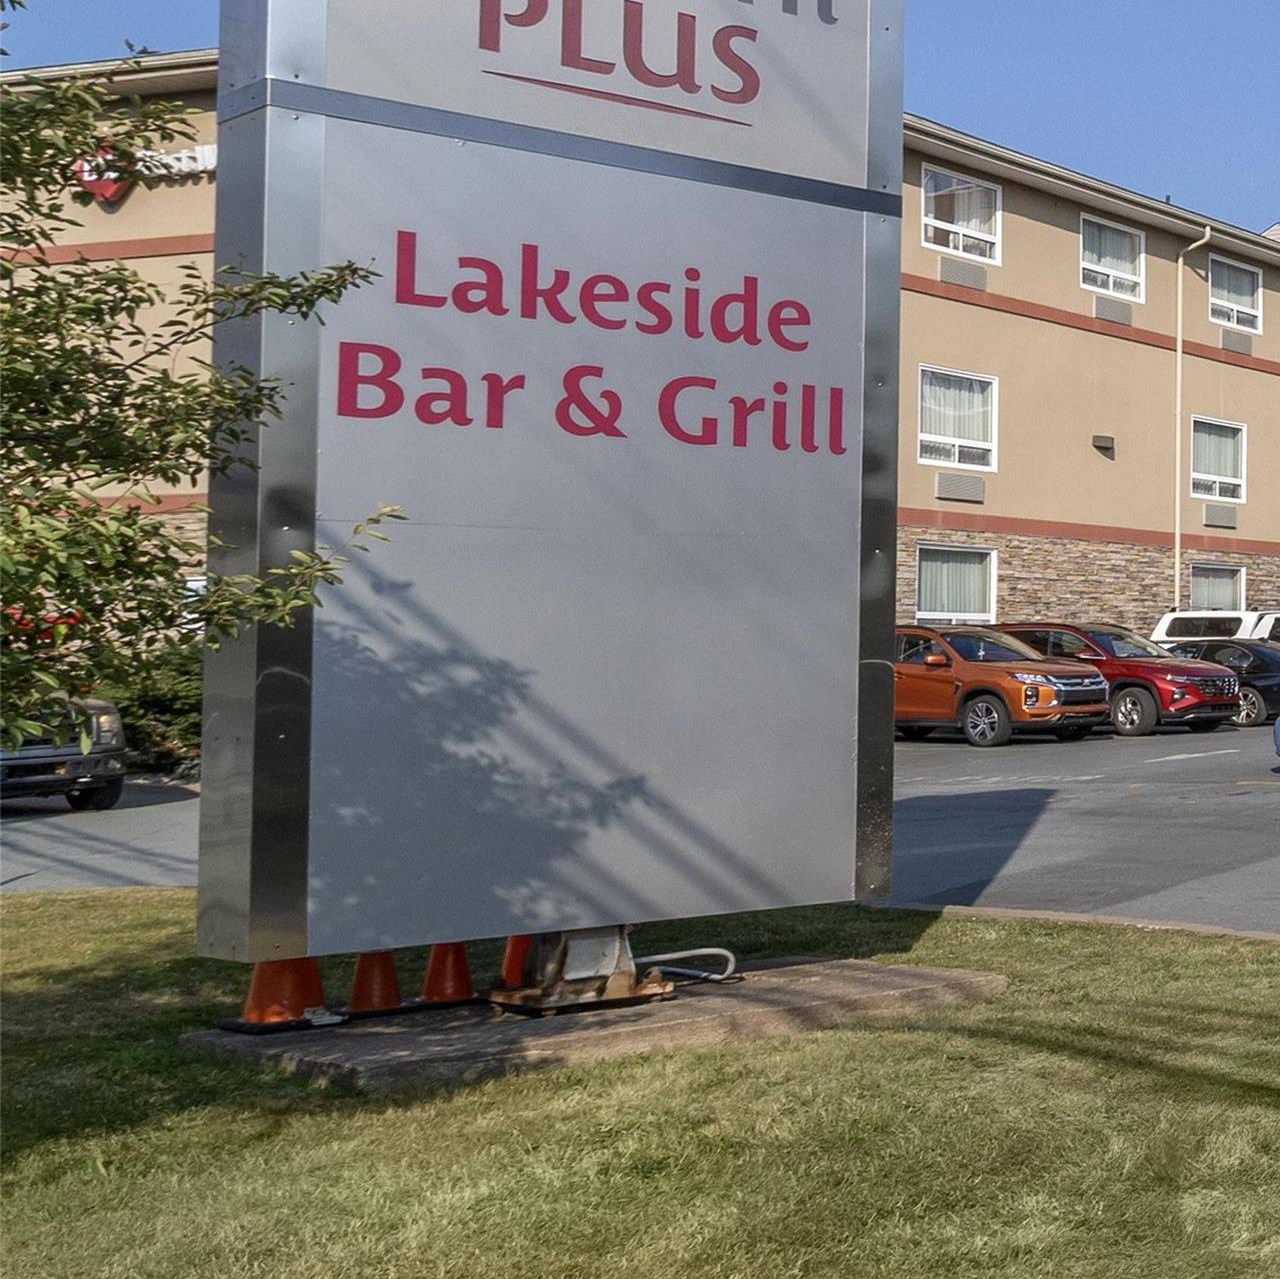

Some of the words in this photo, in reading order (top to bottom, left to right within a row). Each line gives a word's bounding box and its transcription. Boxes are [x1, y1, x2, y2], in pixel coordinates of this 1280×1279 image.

[394, 229, 812, 352] Lakeside
[336, 341, 526, 429] Bar
[554, 364, 629, 439] &
[656, 375, 848, 456] Grill
